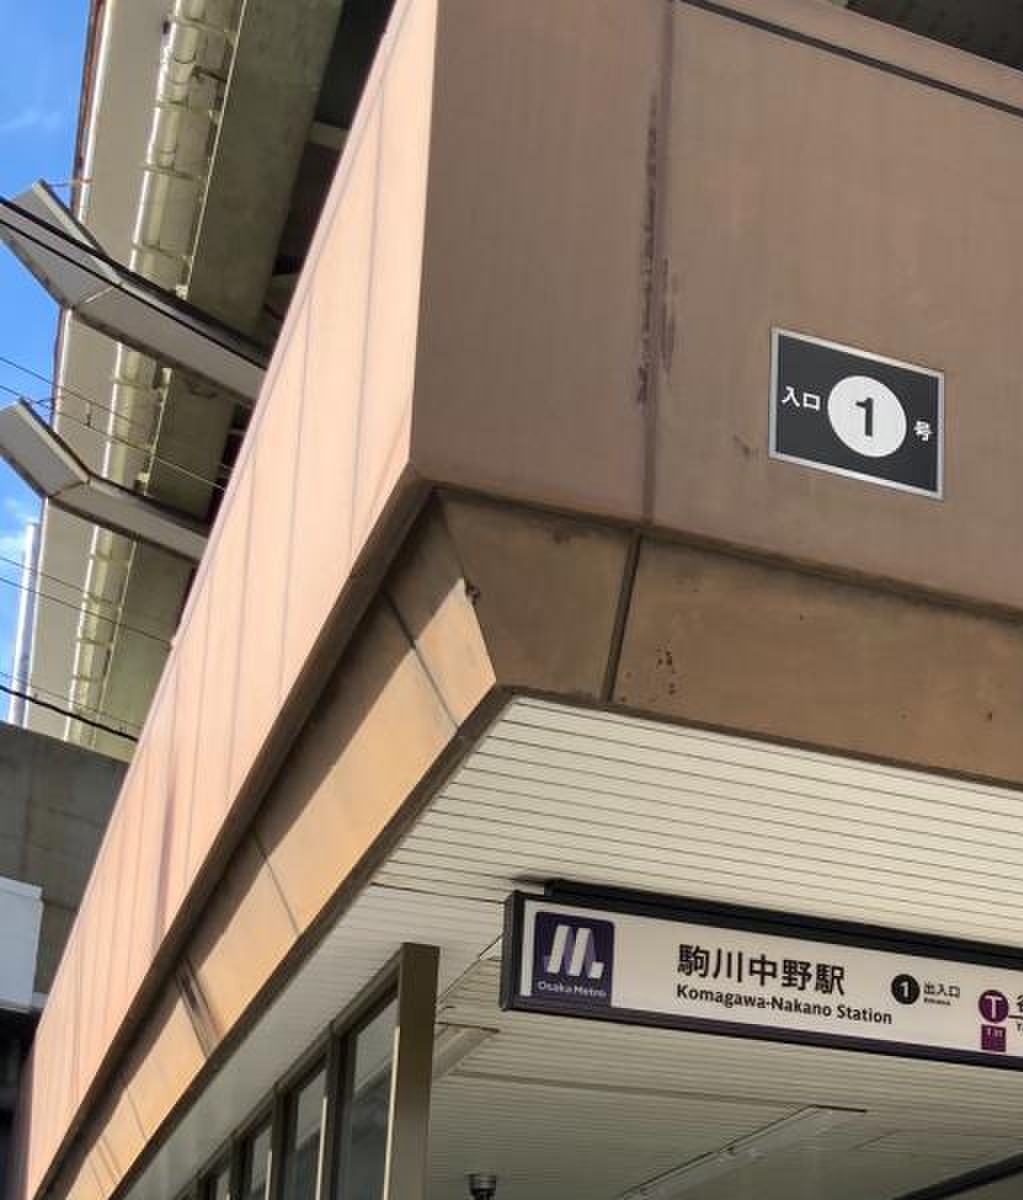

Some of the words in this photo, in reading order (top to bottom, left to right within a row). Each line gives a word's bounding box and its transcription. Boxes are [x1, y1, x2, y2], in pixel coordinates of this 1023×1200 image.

[781, 386, 821, 411] 入口
[854, 397, 874, 437] 1
[913, 420, 933, 441] 号
[676, 943, 846, 996] 駒川中野駅
[901, 981, 909, 998] 1
[676, 983, 833, 1017] Komagawa-Nakano
[837, 1004, 893, 1025] Station
[985, 995, 1004, 1019] T
